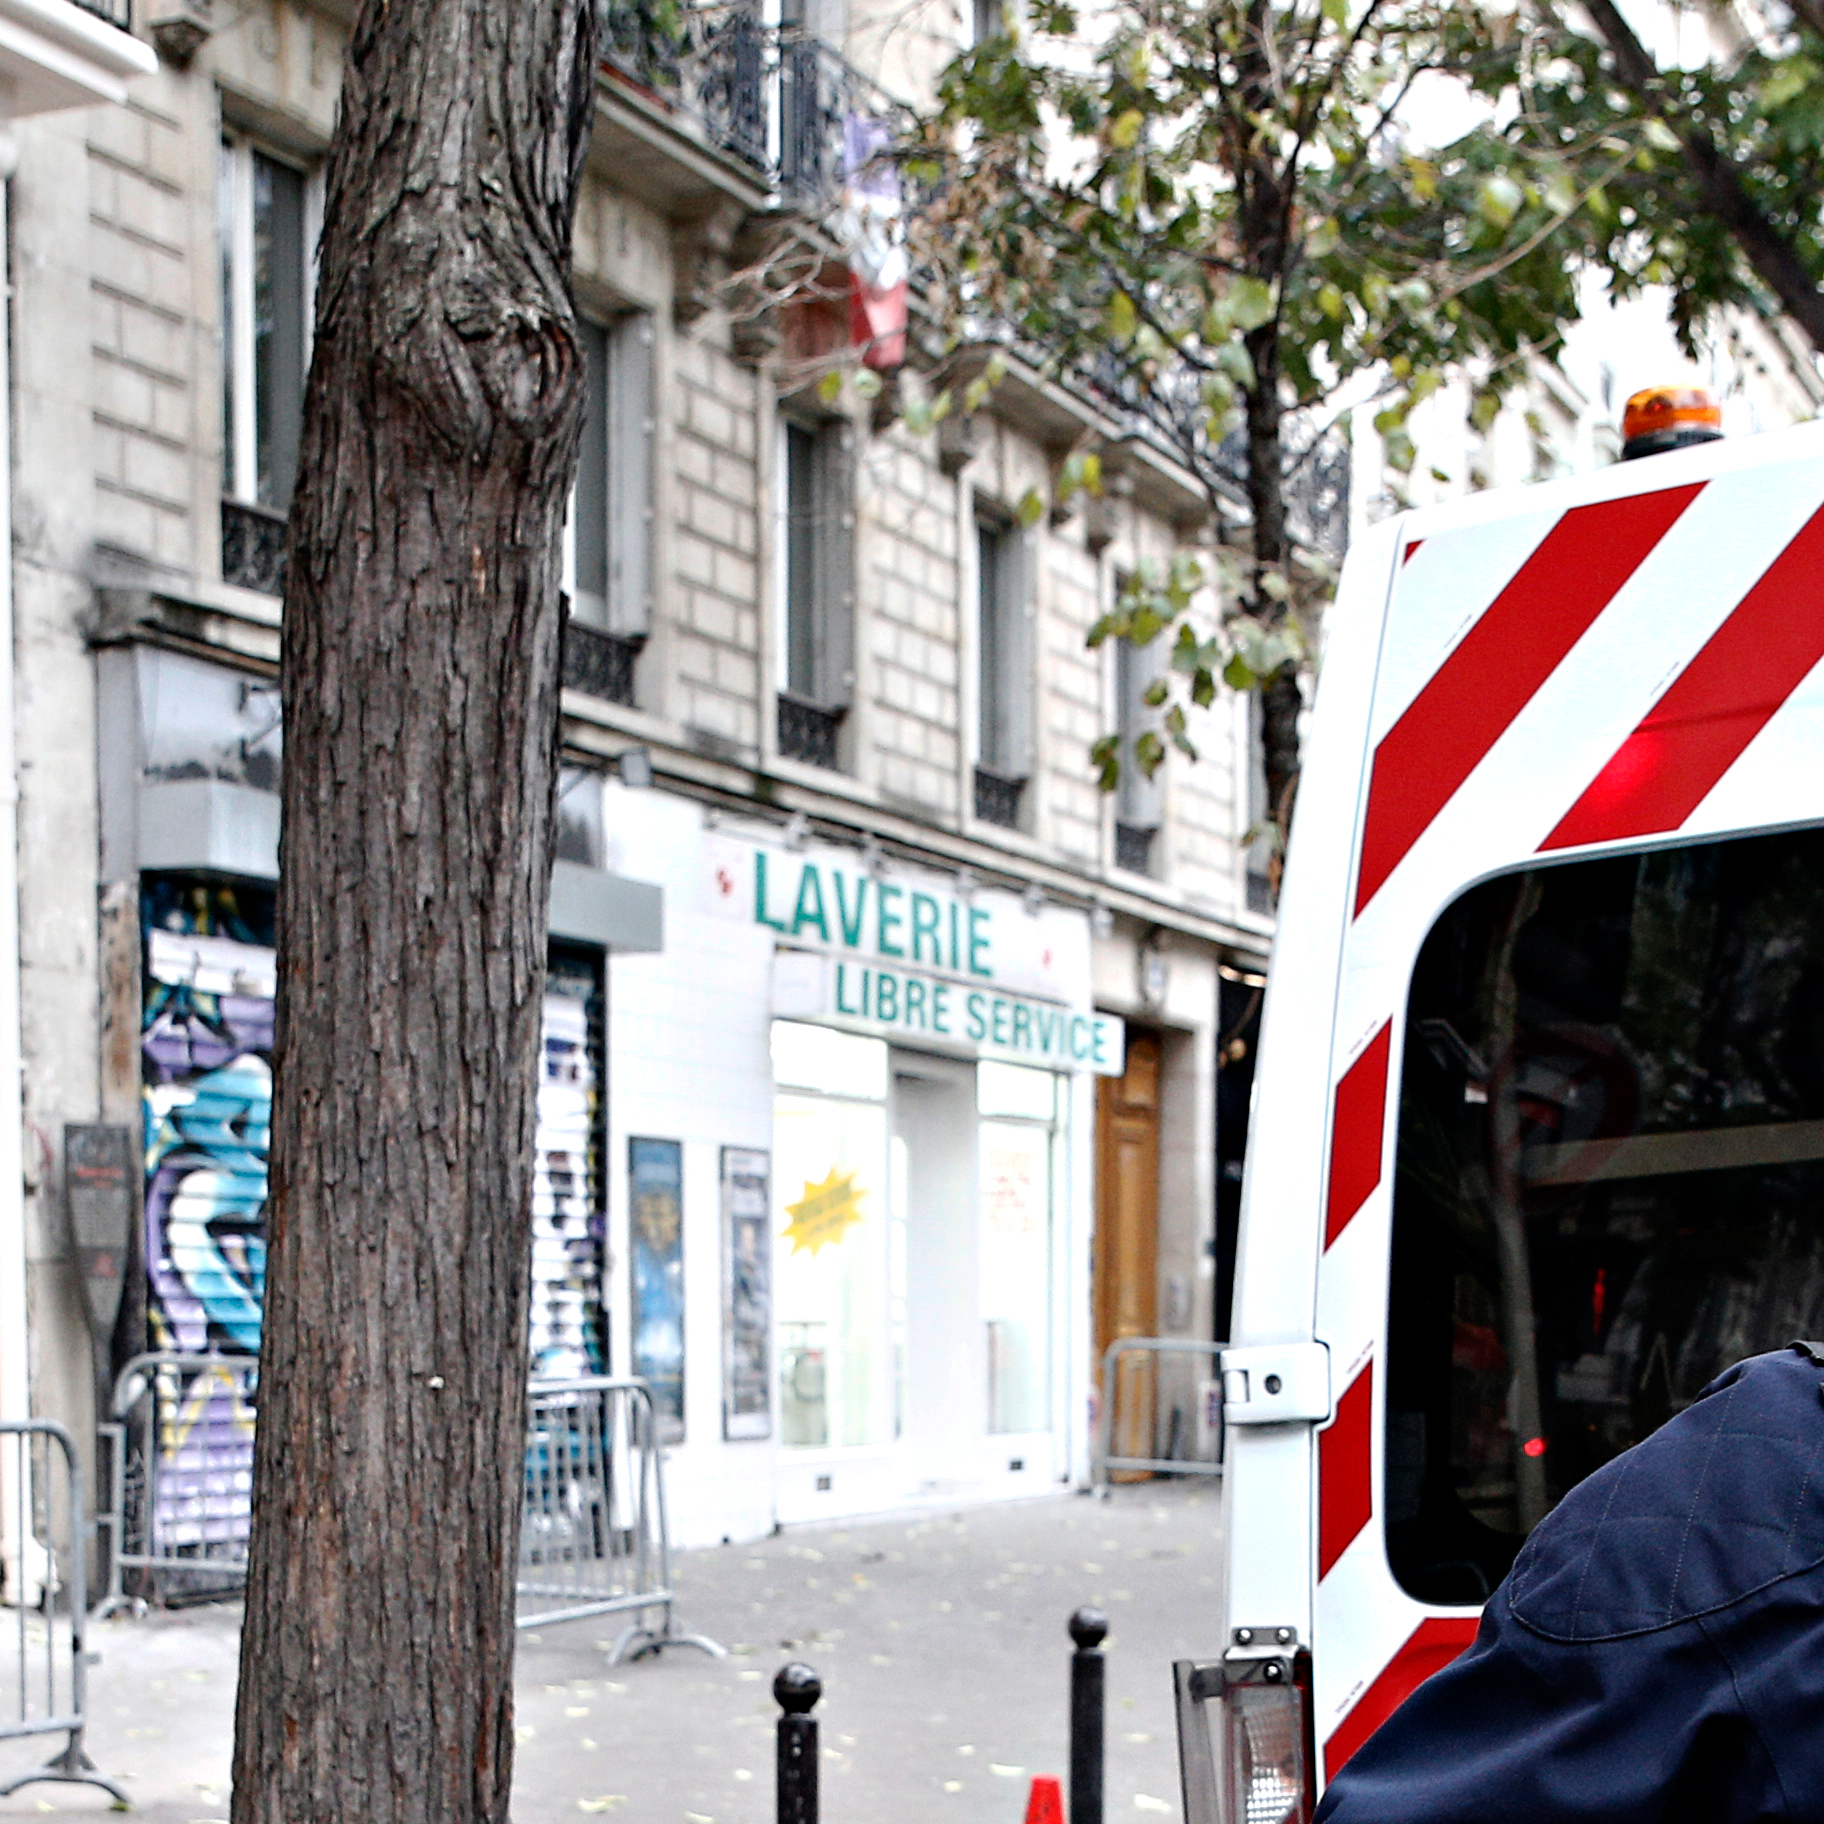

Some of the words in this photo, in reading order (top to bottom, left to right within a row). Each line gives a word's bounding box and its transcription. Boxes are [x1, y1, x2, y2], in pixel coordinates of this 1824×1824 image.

[754, 850, 994, 979] LAVERIE
[835, 962, 952, 1035] LIBRE
[966, 991, 1109, 1065] SERVICE
